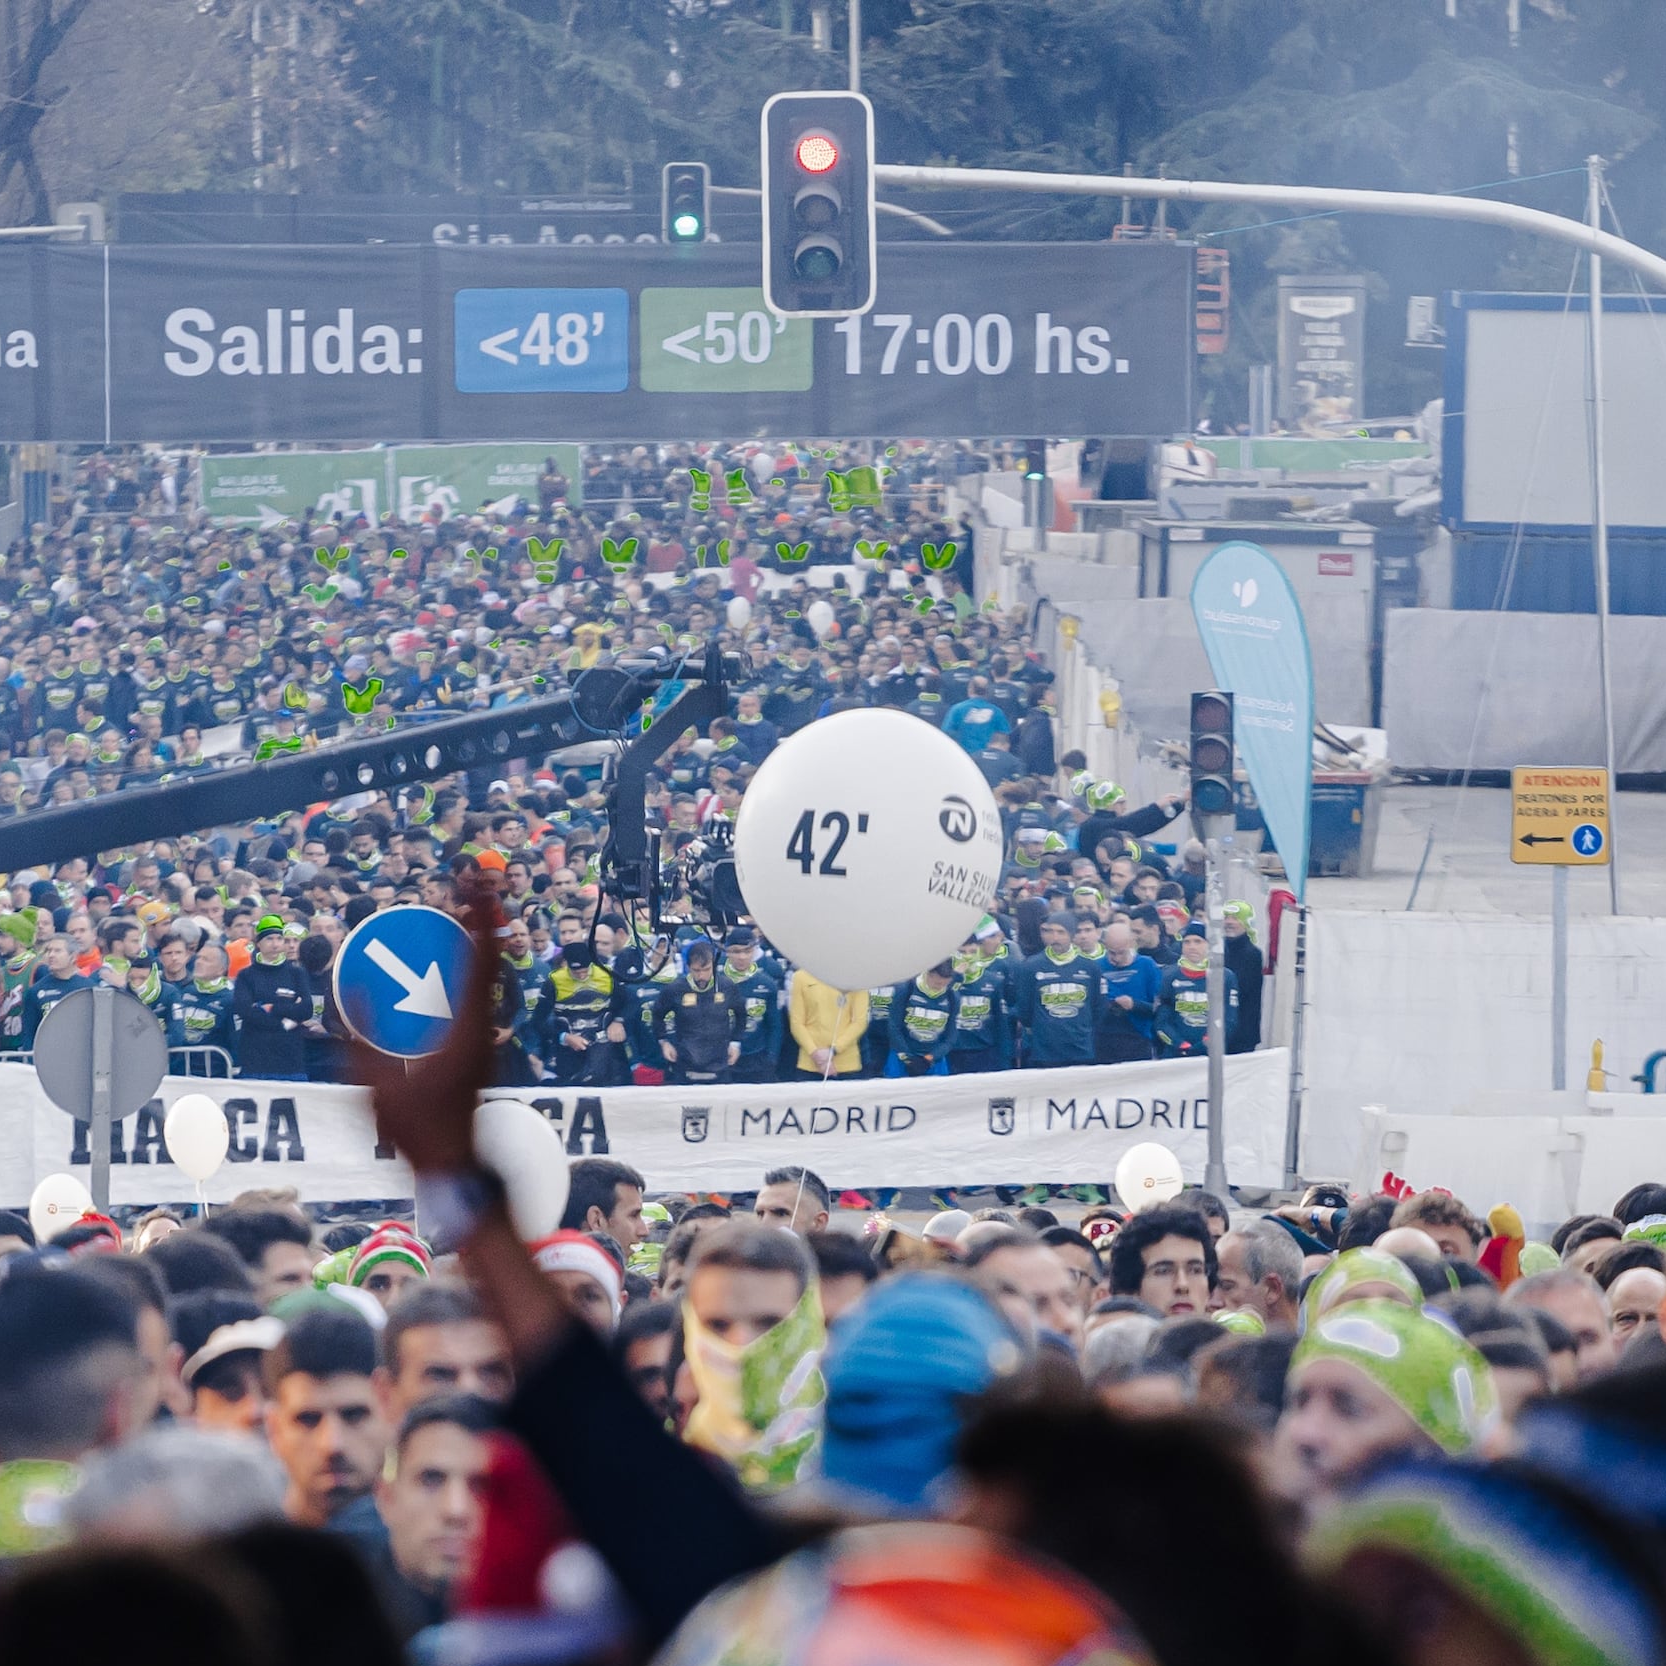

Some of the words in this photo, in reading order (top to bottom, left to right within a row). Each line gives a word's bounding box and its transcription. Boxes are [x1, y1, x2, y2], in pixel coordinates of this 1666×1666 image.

[163, 306, 423, 379] Salida:
[477, 308, 605, 368] <48'
[833, 311, 1014, 377] 17:00
[1035, 311, 1130, 377] hs.
[1566, 807, 1606, 818] PARES
[1583, 794, 1604, 804] POR
[786, 808, 870, 877] 42'
[932, 860, 968, 884] SAN
[740, 1103, 918, 1137] MADRID
